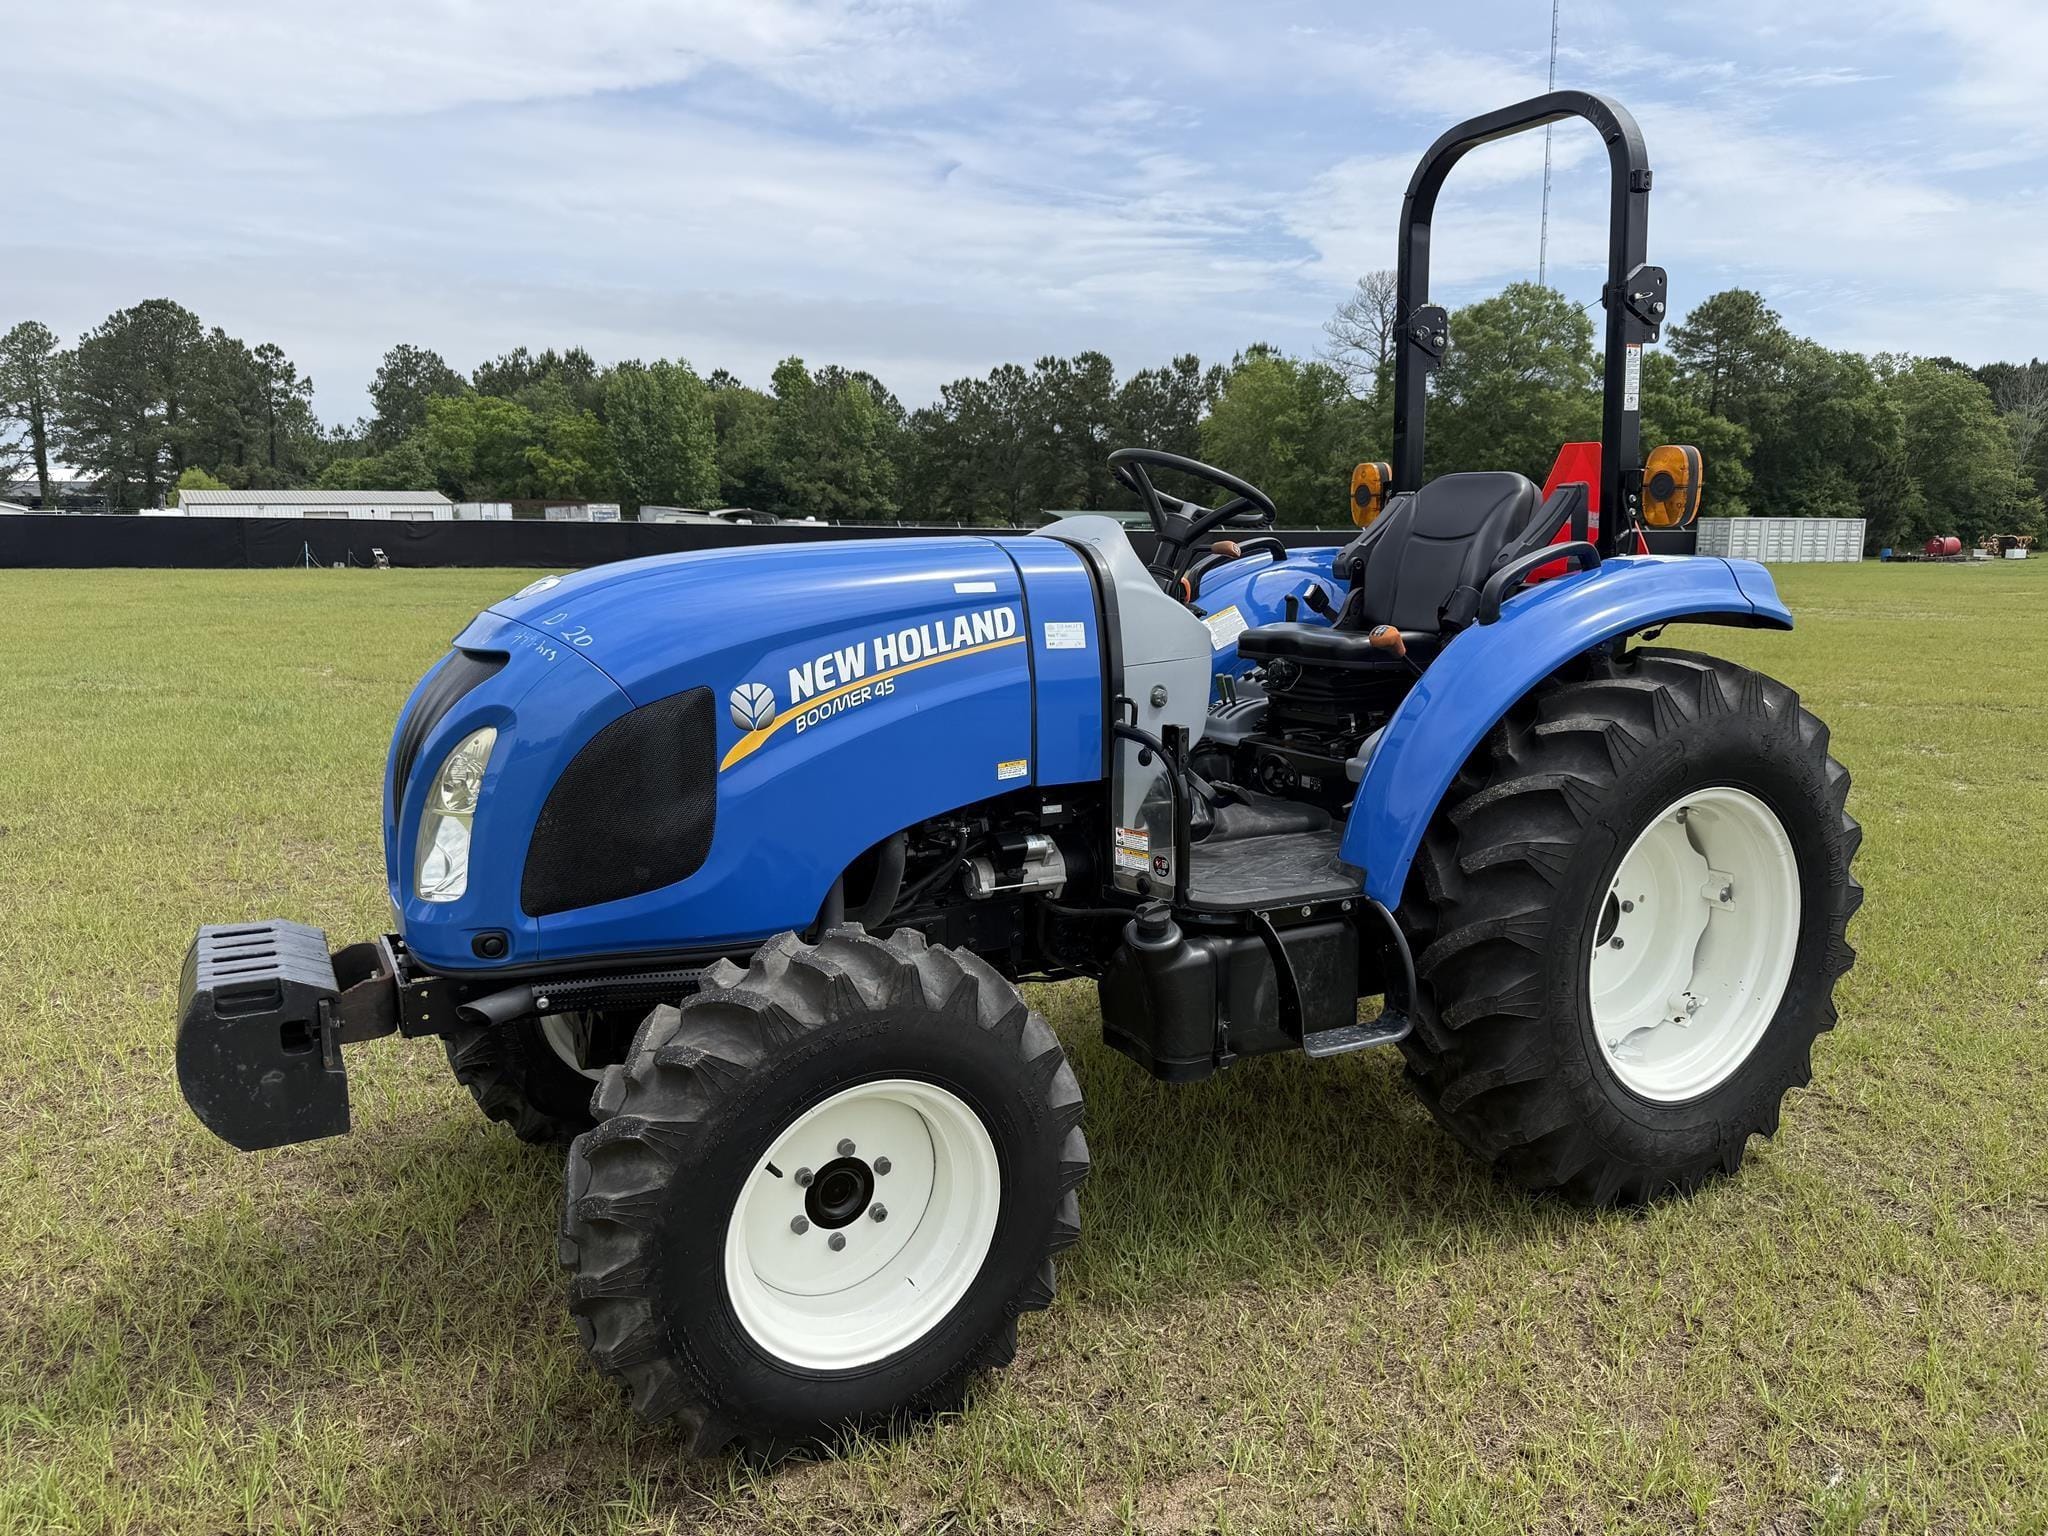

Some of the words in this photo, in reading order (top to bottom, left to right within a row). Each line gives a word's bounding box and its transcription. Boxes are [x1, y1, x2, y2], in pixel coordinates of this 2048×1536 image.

[787, 642, 866, 704] NEW
[873, 606, 1016, 672] HOLLAND
[796, 684, 872, 735] BOOMER
[874, 678, 895, 698] 45
